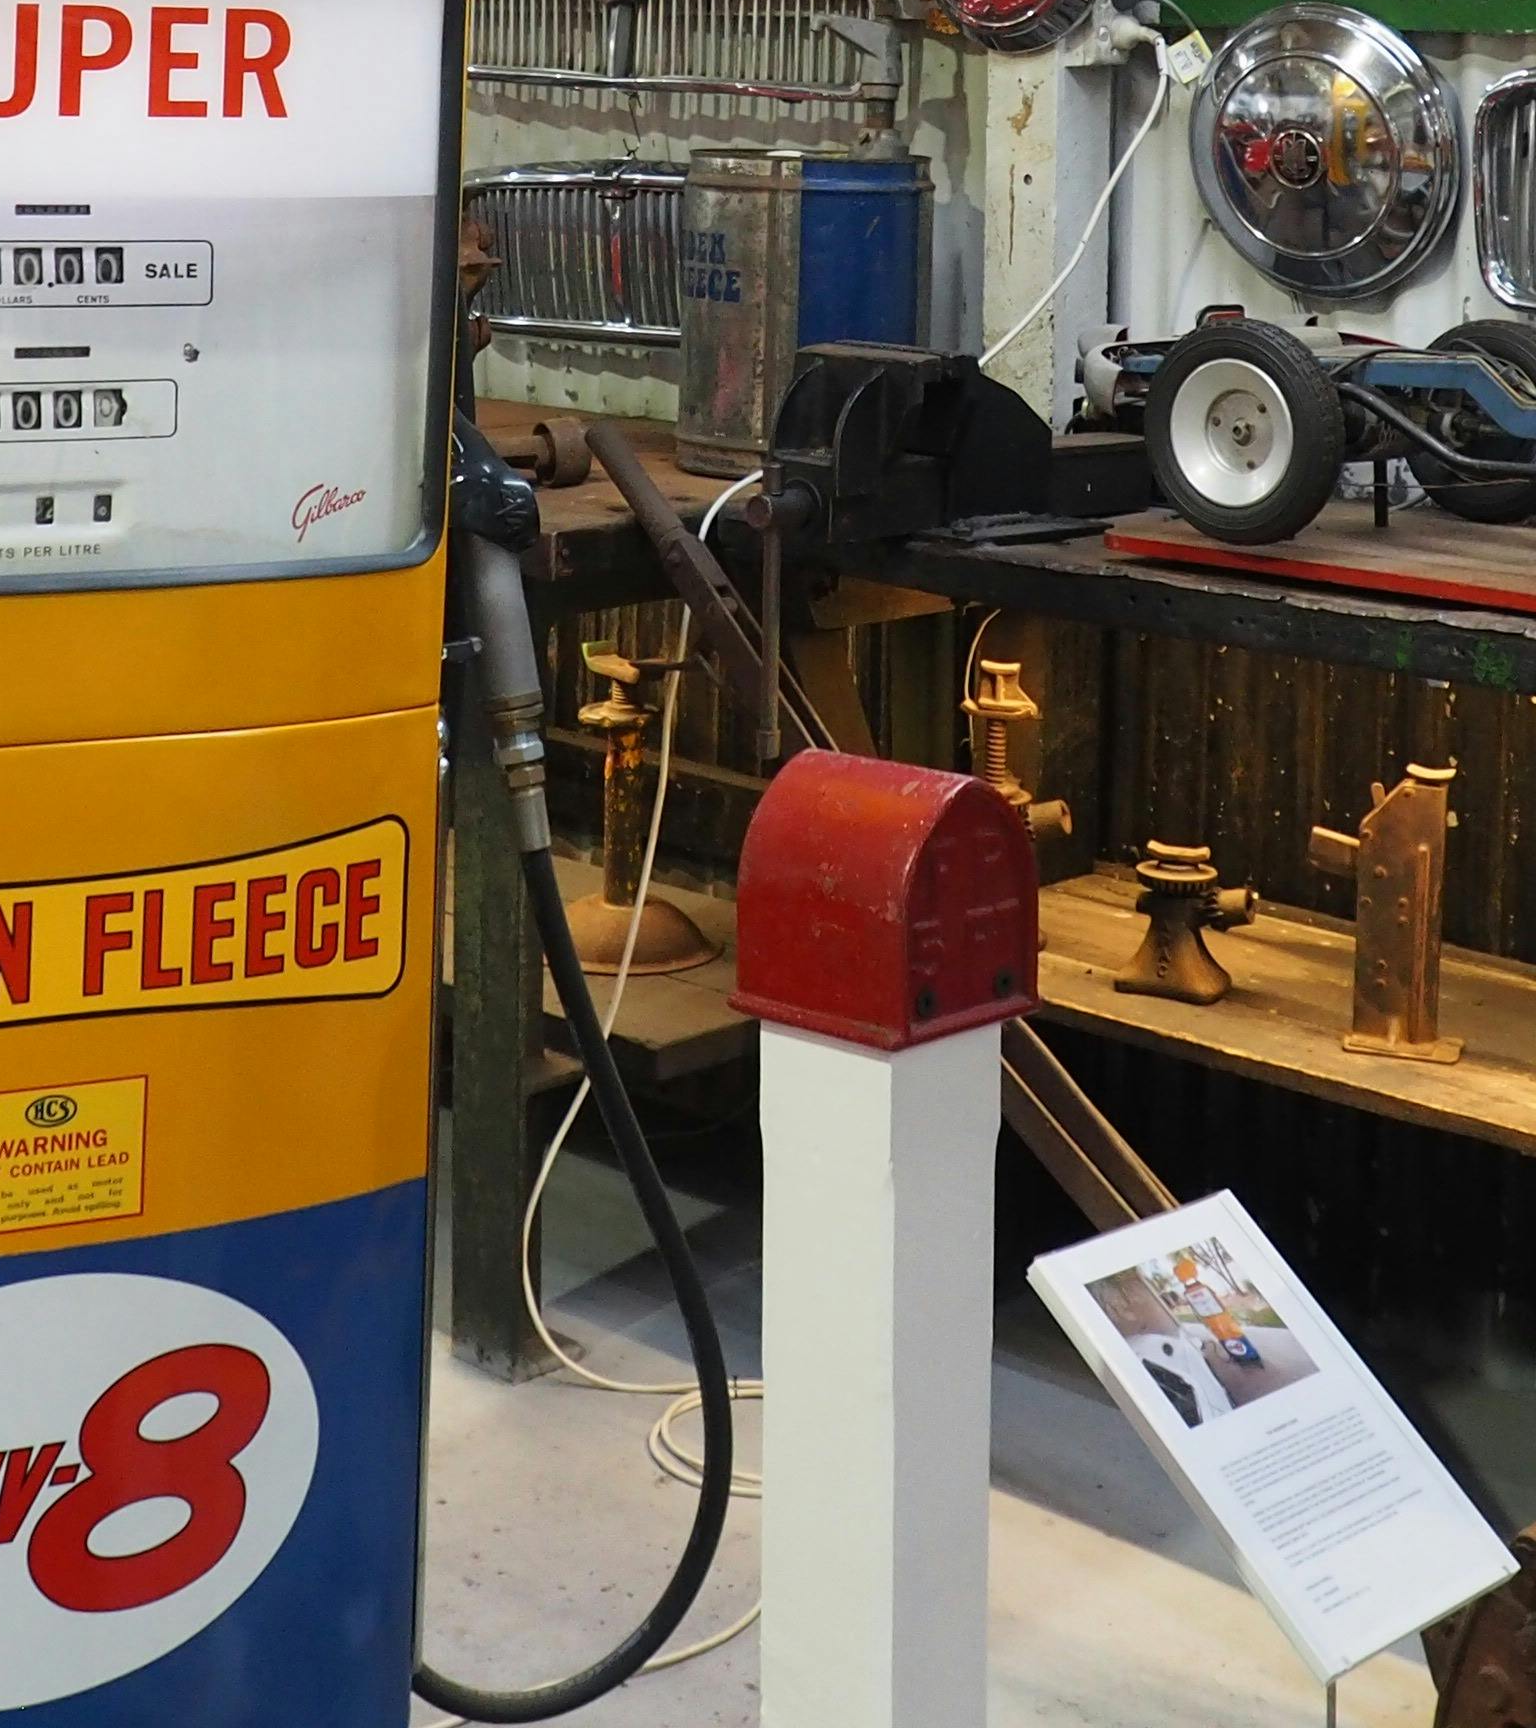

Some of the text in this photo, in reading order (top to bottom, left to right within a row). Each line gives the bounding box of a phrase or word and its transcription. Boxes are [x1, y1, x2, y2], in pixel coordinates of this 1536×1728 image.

[144, 263, 198, 279] SALE
[77, 294, 110, 304] CENTS
[291, 483, 366, 543] Gilbarco
[24, 546, 52, 558] PER
[59, 544, 101, 557] LITRE
[82, 858, 382, 998] FLEECE
[10, 1158, 80, 1178] CONTAIN
[87, 1152, 129, 1168] LEAD
[28, 1185, 54, 1196] used
